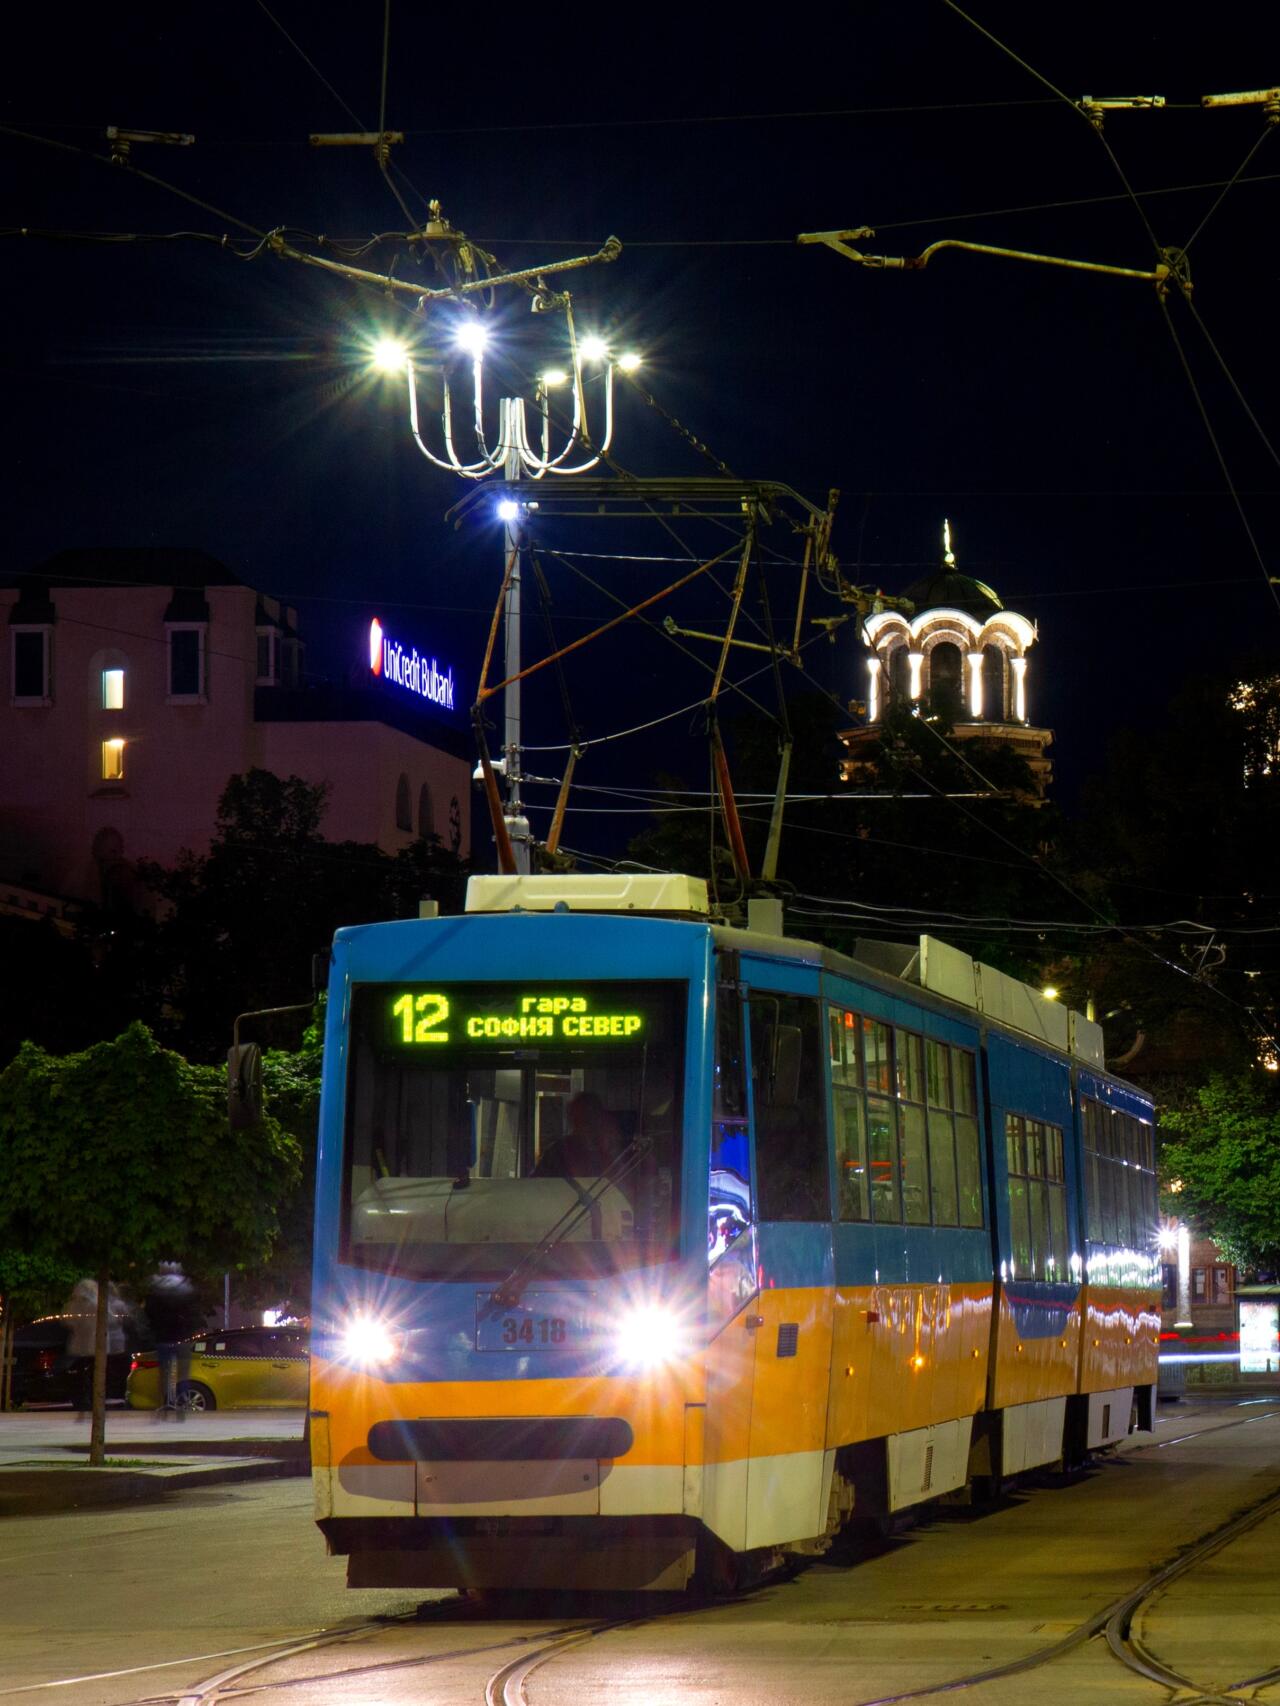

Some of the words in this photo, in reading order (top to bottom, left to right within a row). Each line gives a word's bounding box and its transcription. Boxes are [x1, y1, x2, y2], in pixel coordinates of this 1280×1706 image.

[383, 638, 420, 694] UniCredit
[421, 656, 454, 706] Bulbank
[393, 993, 449, 1043] 12
[521, 997, 587, 1015] гара
[467, 1016, 554, 1037] СОФИЯ
[562, 1015, 642, 1036] СЕВЕР
[502, 1317, 566, 1344] 3418
